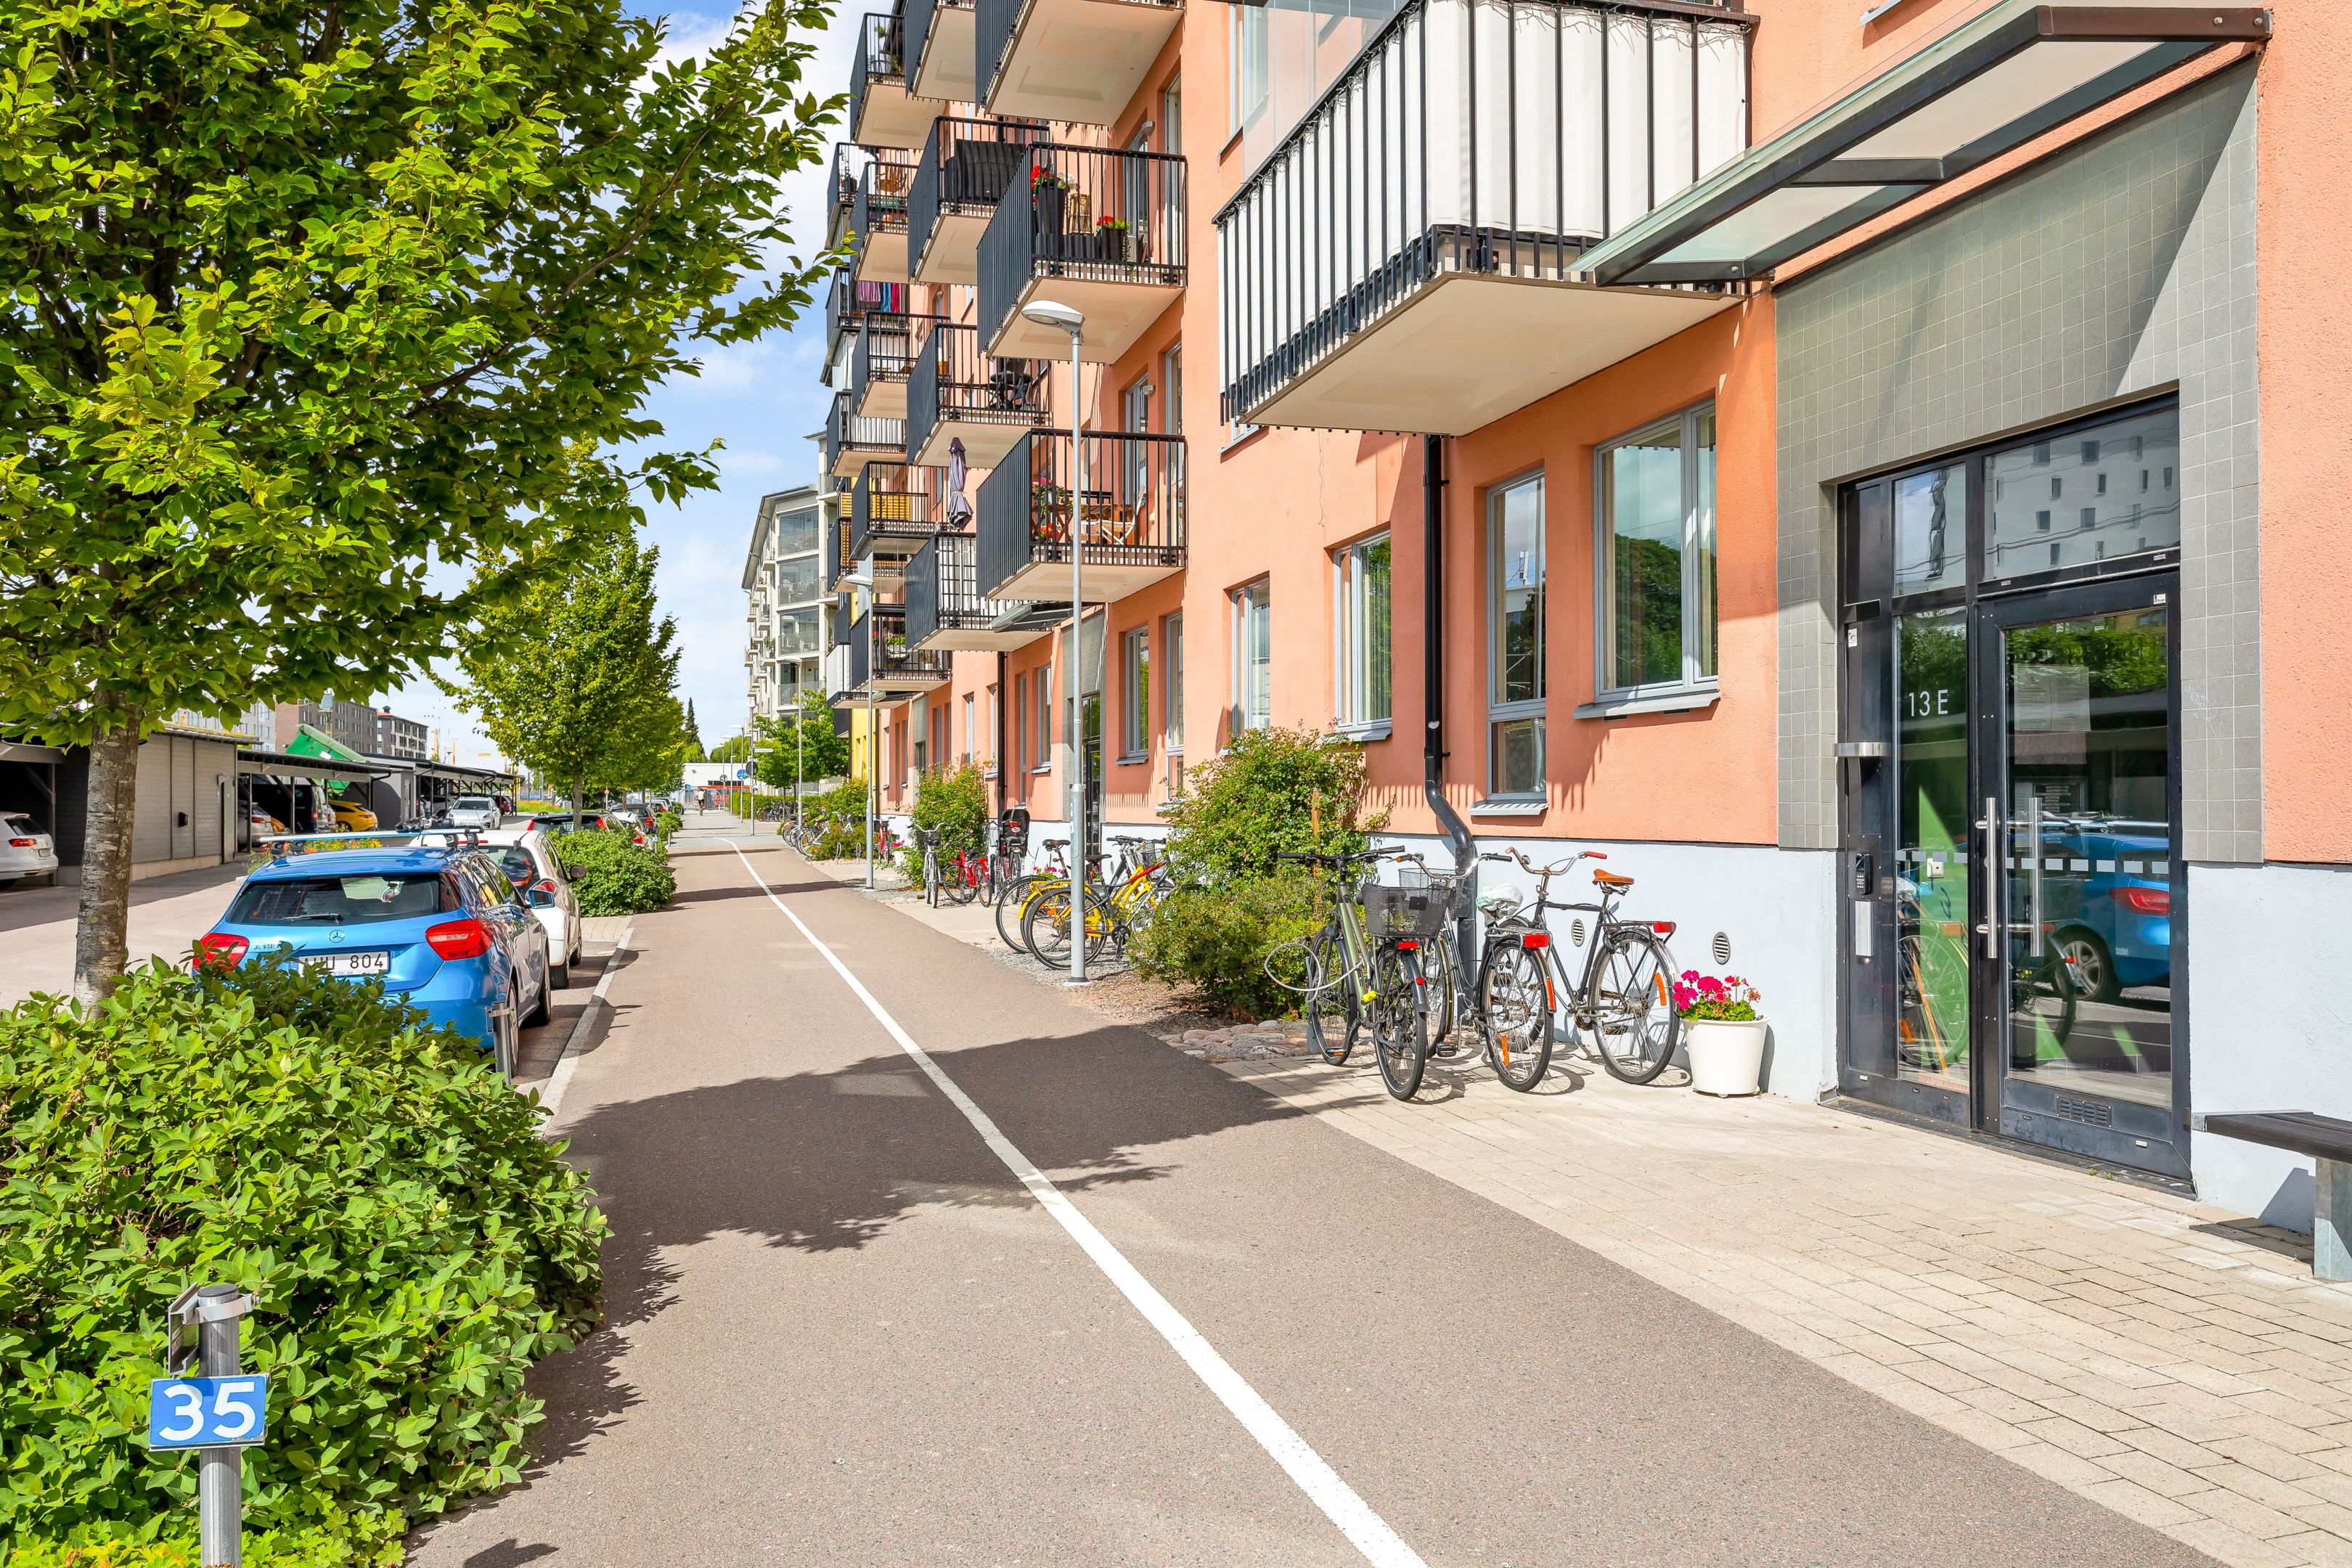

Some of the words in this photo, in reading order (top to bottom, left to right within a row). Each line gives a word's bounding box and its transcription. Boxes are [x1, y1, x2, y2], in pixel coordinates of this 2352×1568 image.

[1908, 690, 1930, 716] 13
[1937, 689, 1948, 715] E
[350, 953, 383, 969] 804
[158, 1381, 256, 1442] 35
